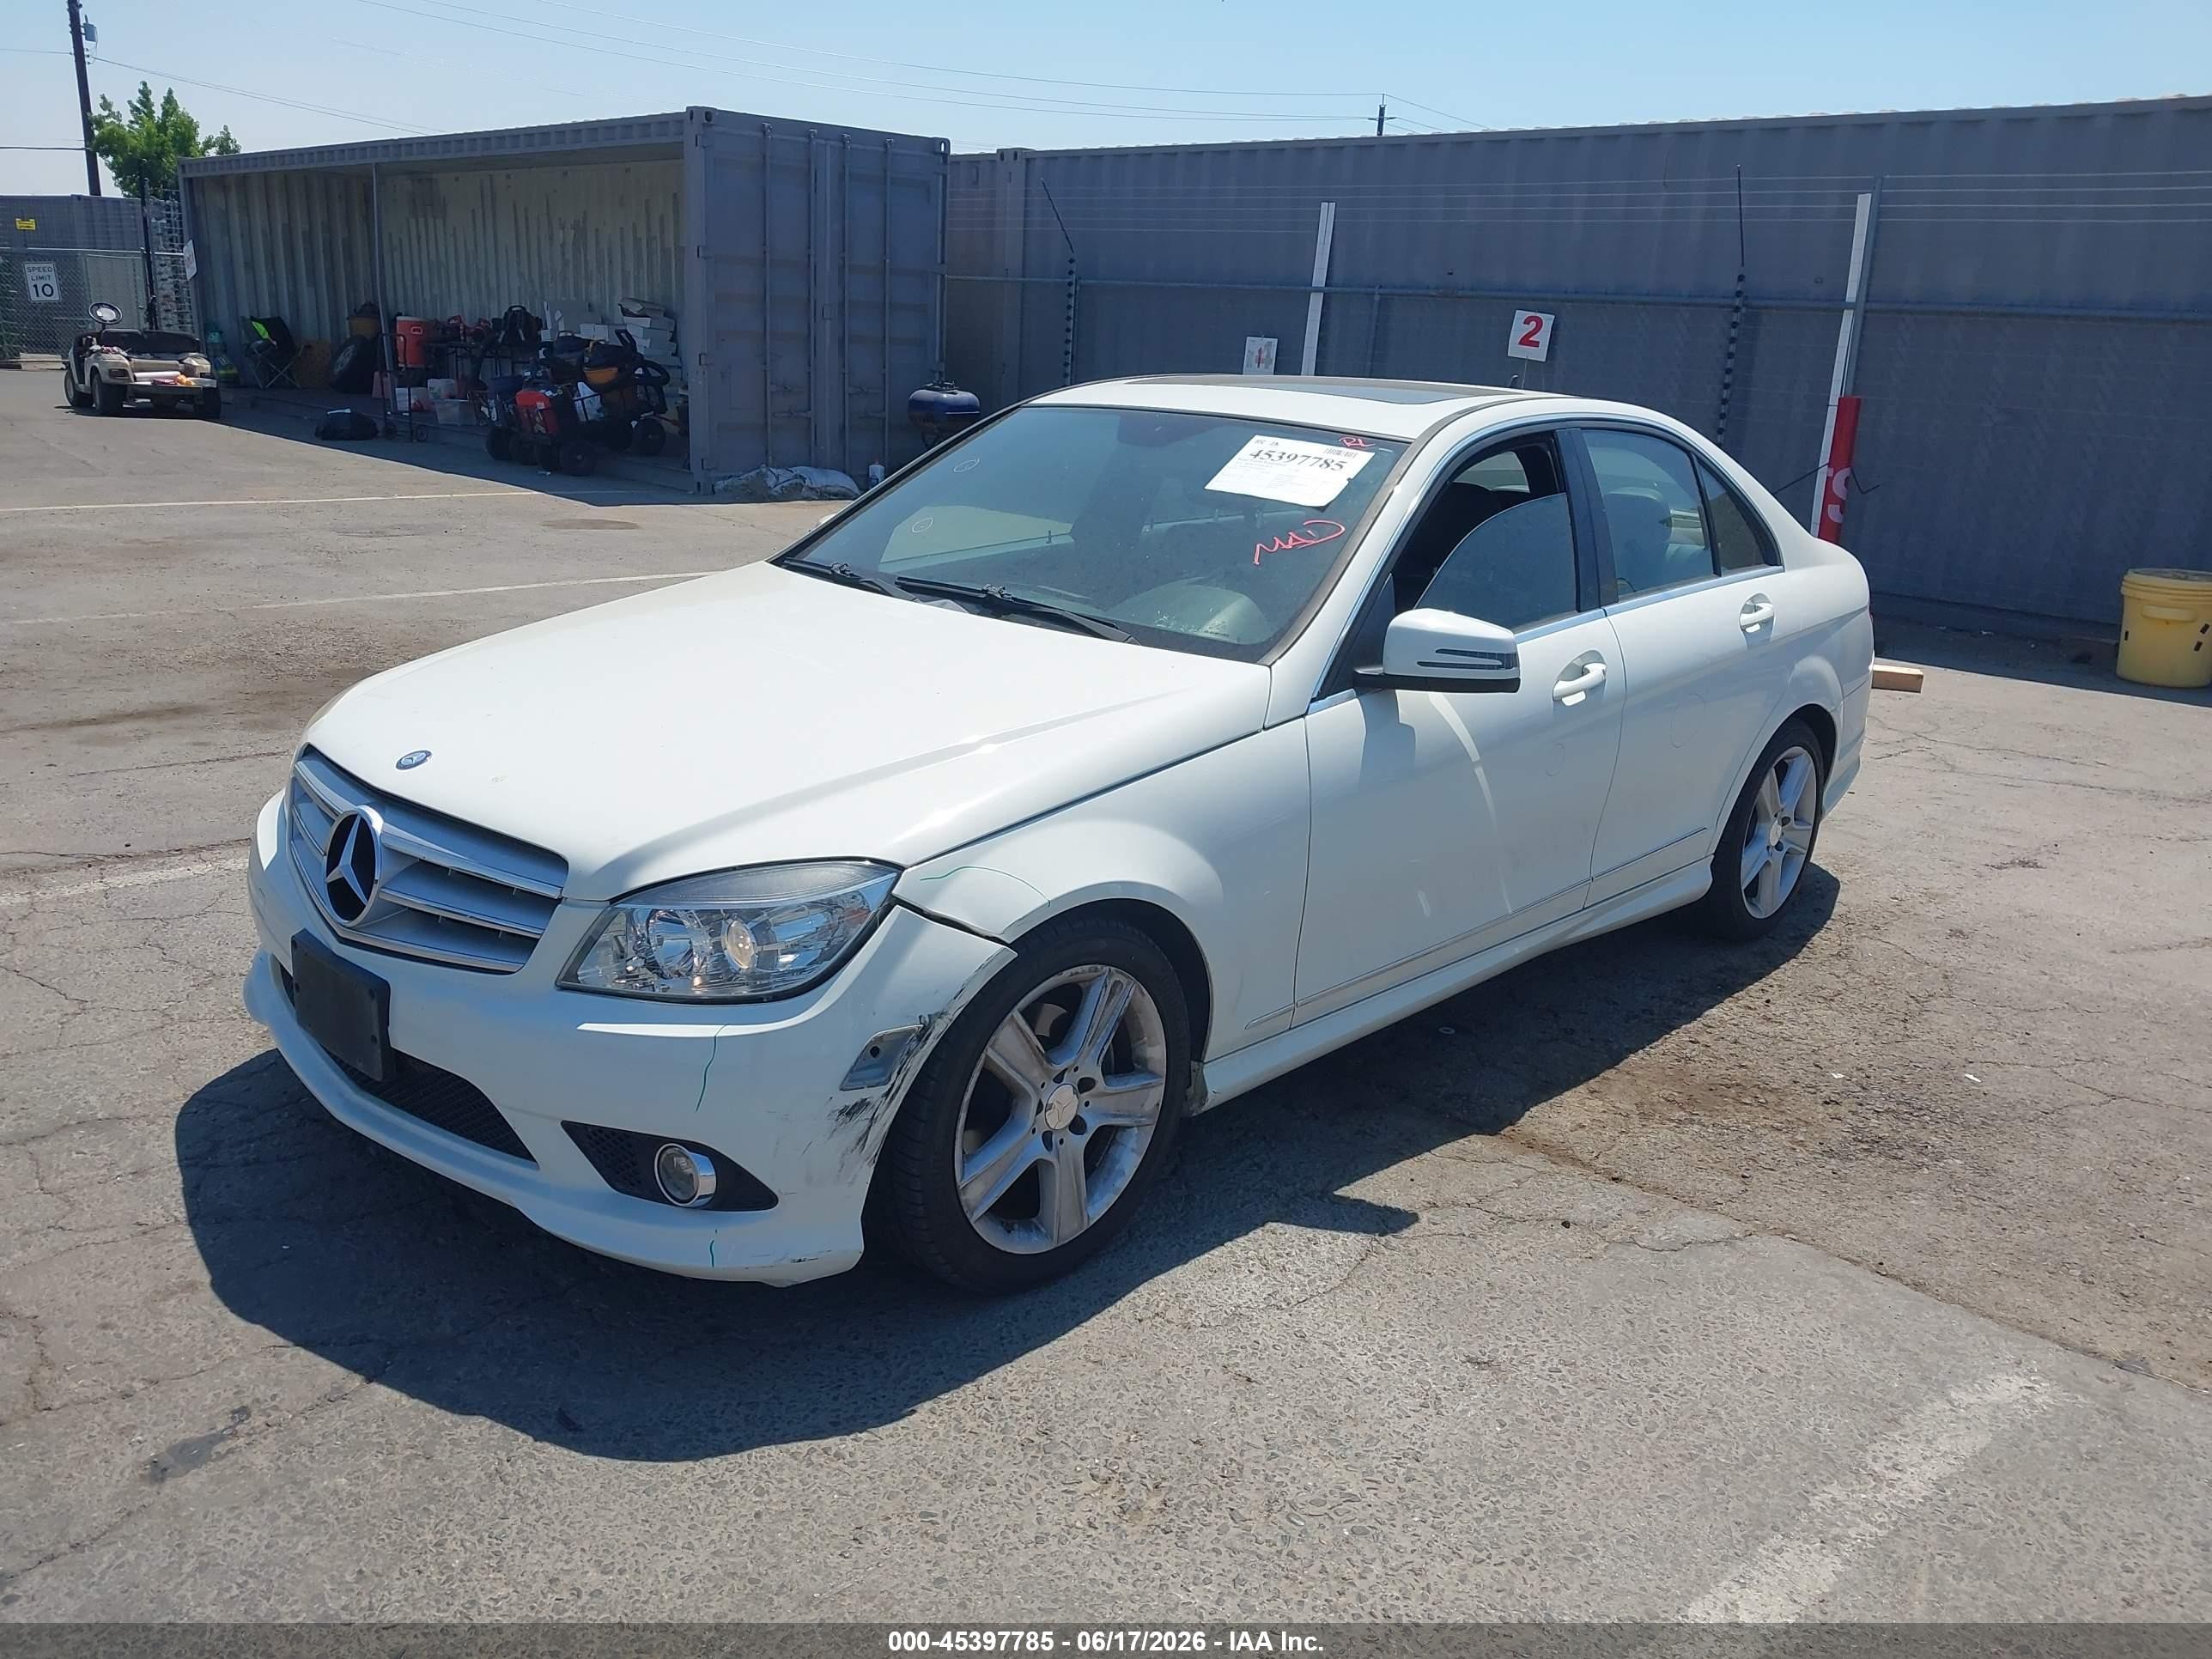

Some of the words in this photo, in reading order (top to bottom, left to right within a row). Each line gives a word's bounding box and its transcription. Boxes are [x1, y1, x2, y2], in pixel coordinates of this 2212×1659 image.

[33, 283, 54, 298] 10
[1517, 314, 1544, 348] 2
[1249, 448, 1347, 471] 45397785
